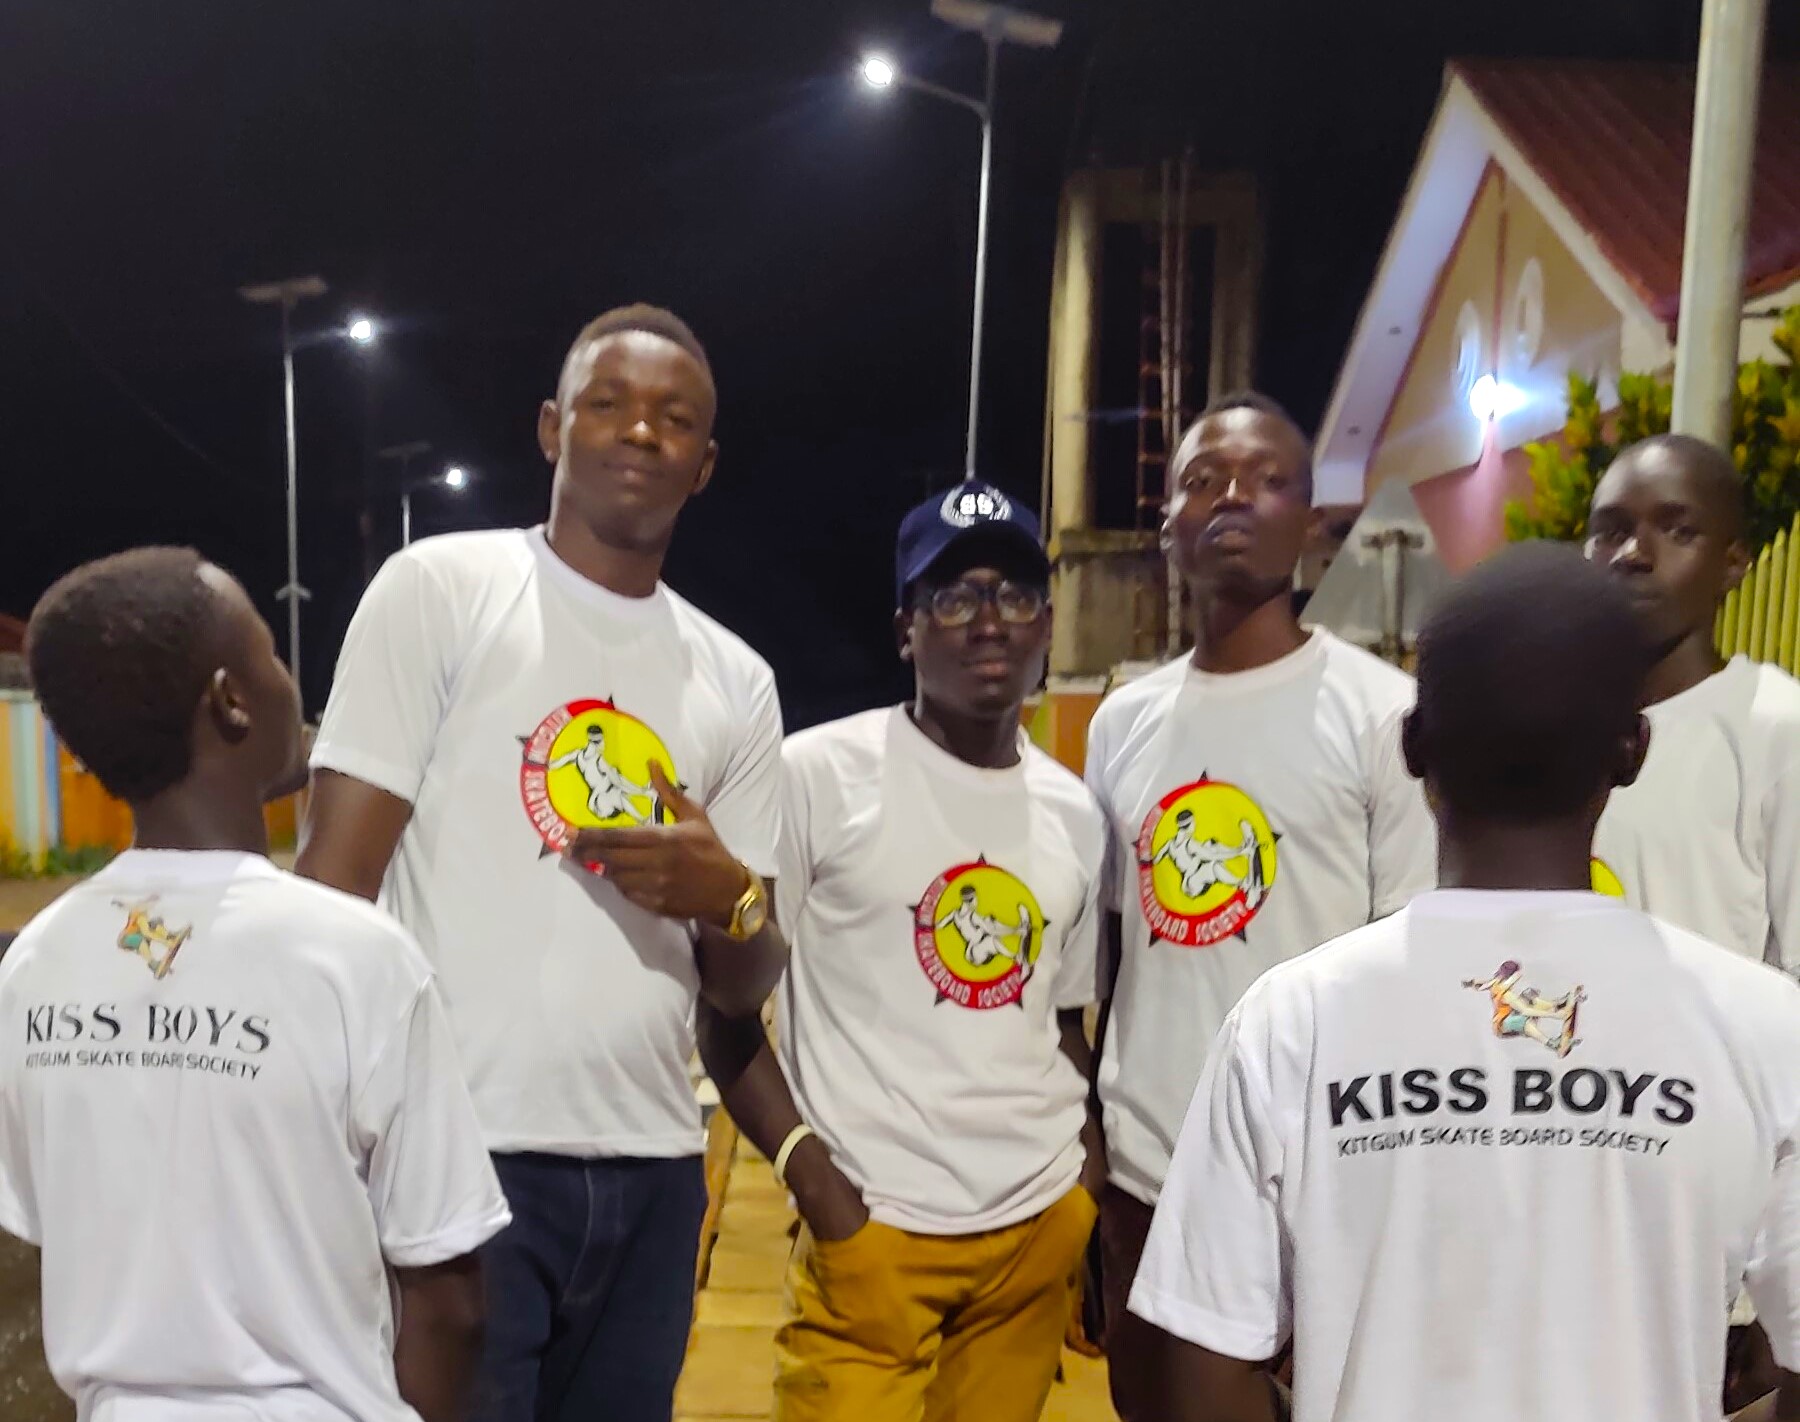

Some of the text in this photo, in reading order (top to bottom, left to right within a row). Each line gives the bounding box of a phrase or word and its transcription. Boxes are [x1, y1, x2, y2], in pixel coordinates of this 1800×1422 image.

[26, 1004, 271, 1054] KISS BOYS
[77, 1050, 134, 1067] SKATE
[186, 1055, 261, 1080] SOCIETY
[1327, 1067, 1696, 1128] KISS BOYS
[1337, 1125, 1672, 1158] KITGUM SKATE BOARD SOCIETY
